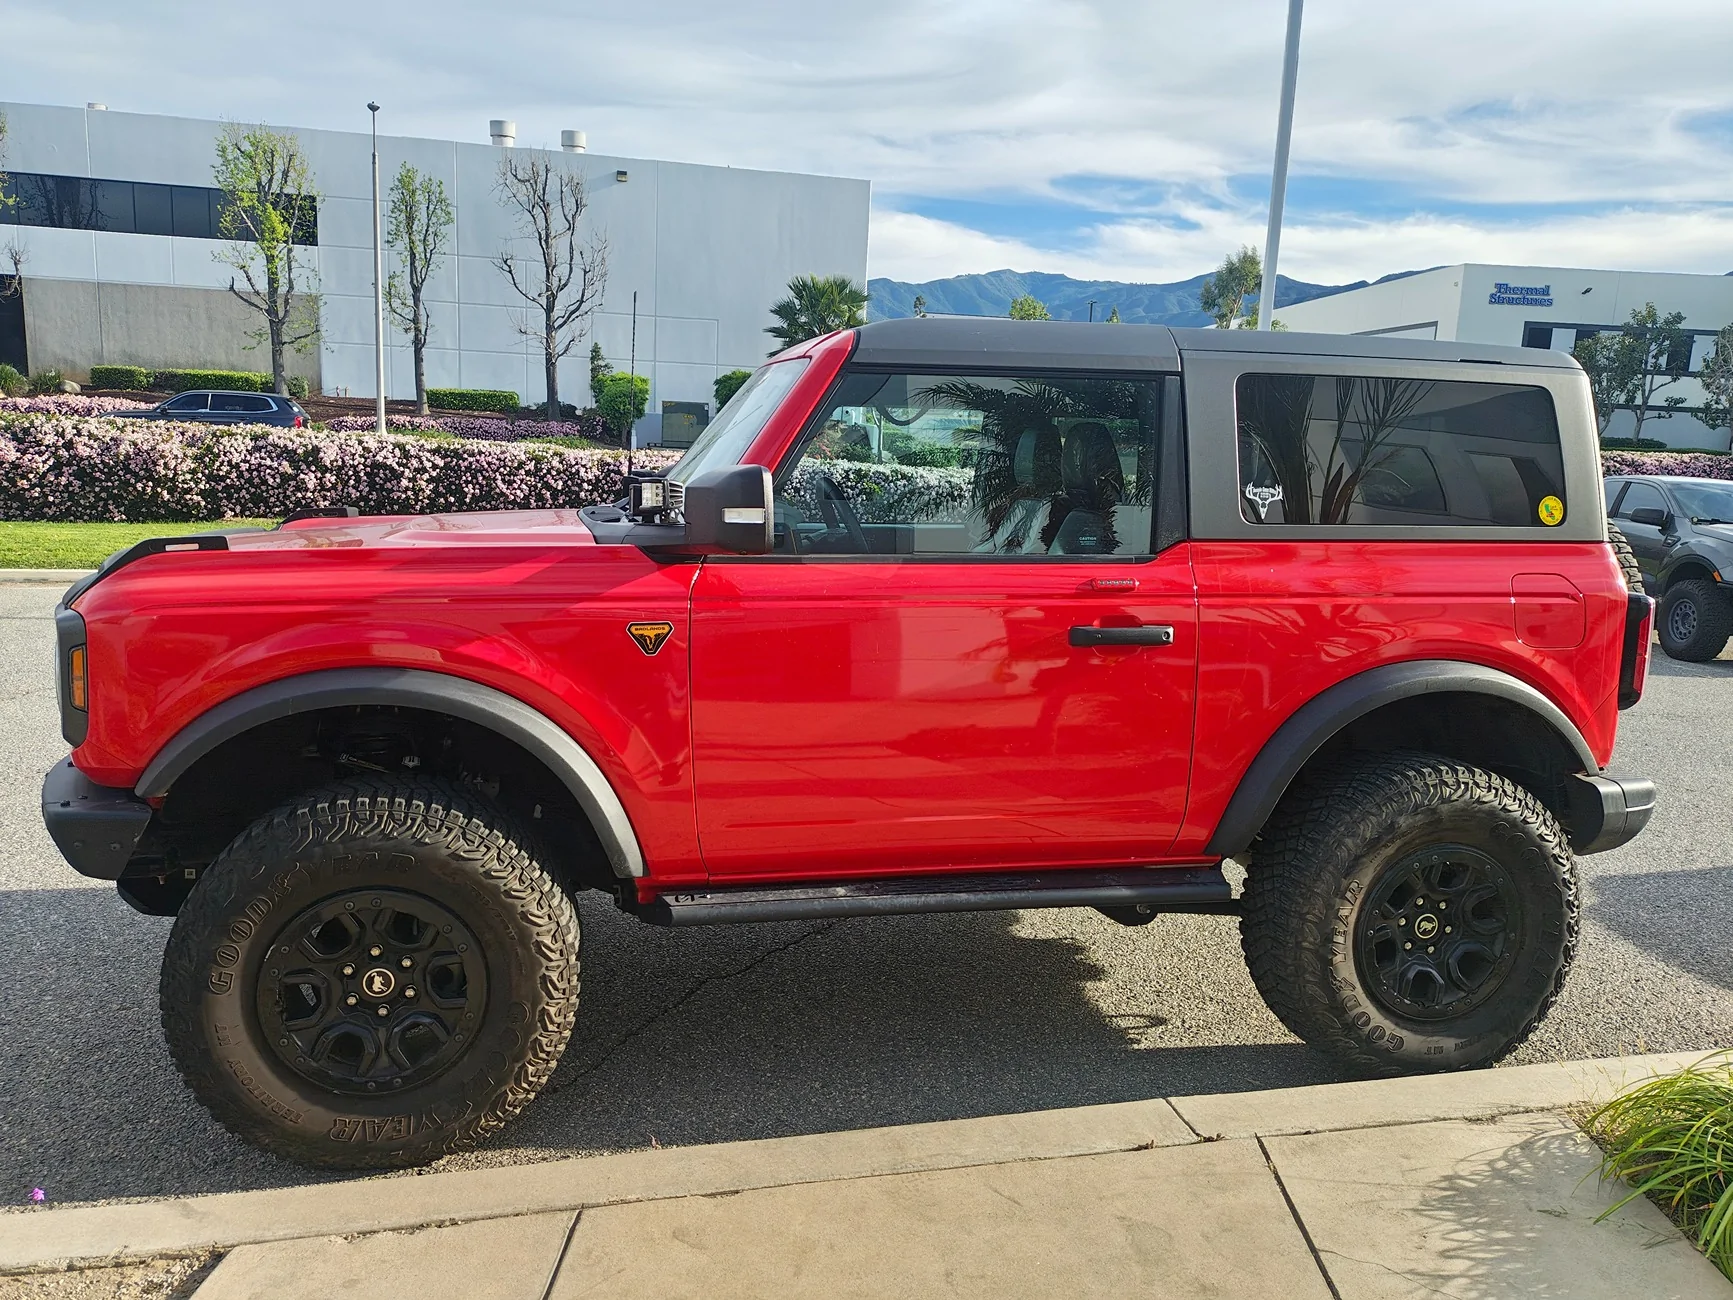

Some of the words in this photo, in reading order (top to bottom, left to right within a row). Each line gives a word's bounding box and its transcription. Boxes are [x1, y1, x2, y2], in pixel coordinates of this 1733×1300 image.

[1494, 282, 1550, 296] Thermal
[1488, 293, 1553, 307] Structures
[226, 1059, 305, 1124] TERRITORY
